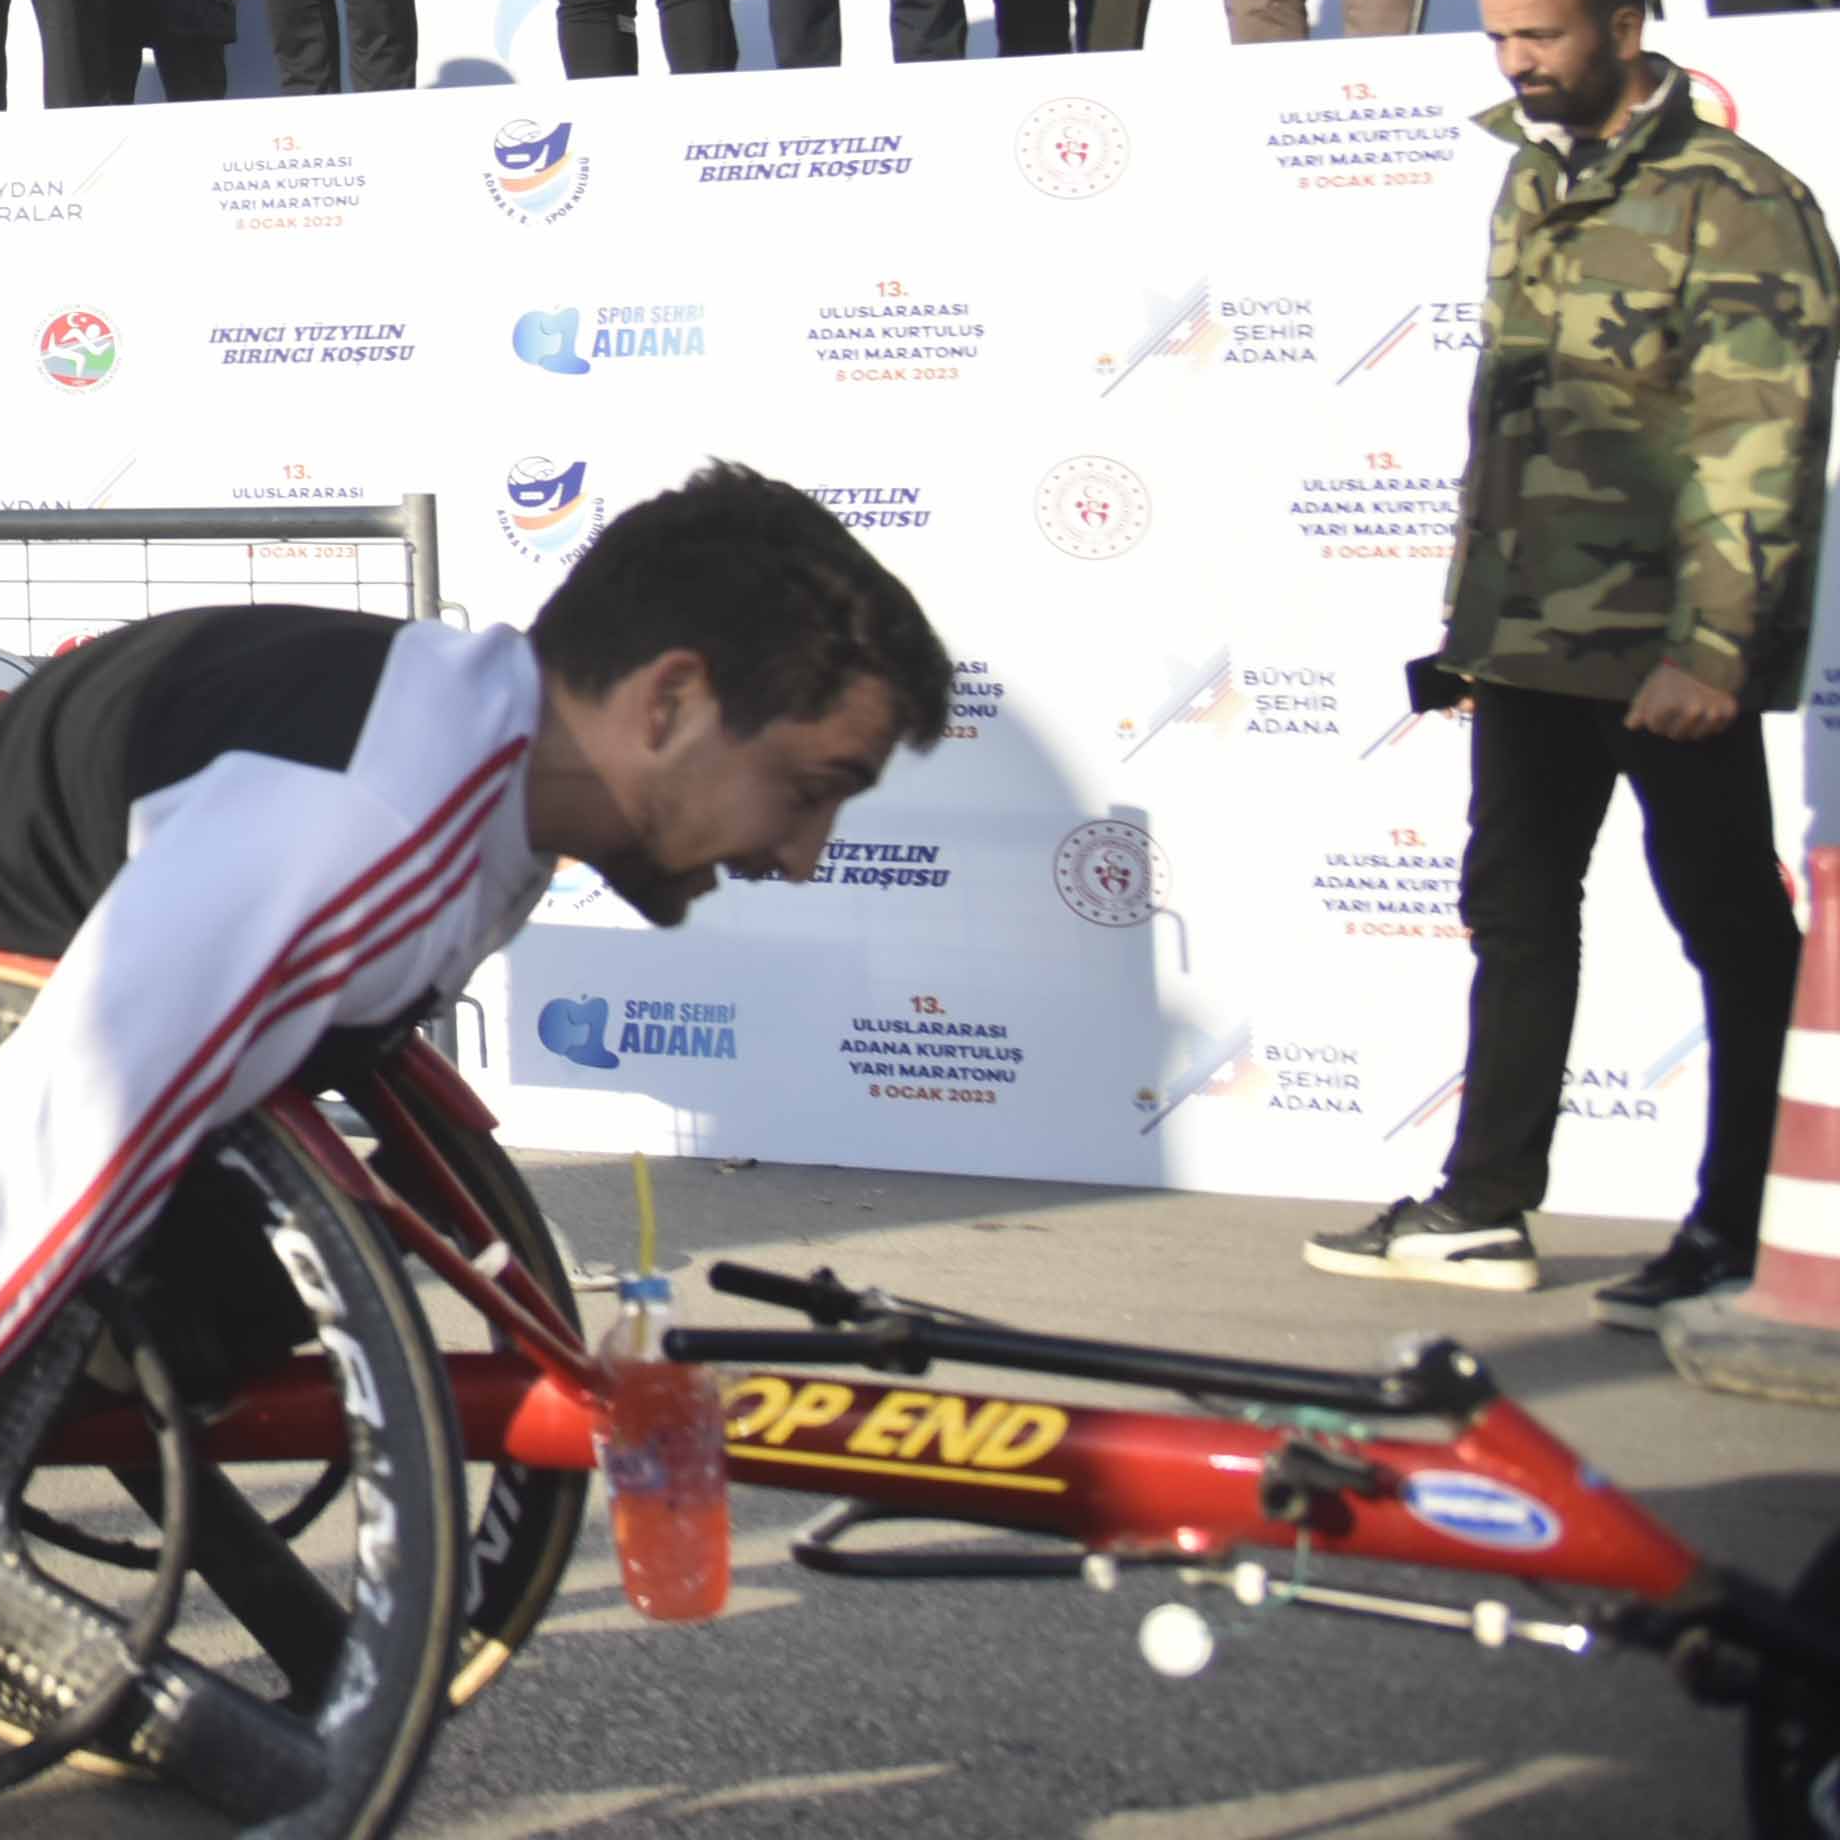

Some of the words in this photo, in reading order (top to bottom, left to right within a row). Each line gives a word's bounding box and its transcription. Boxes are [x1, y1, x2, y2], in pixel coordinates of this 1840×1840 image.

[1221, 296, 1313, 318] BÜYÜK
[1232, 321, 1315, 346] ŞEHİR
[1223, 347, 1316, 366] ADANA
[624, 1000, 675, 1024] SPOR
[678, 1002, 738, 1028] ŞEHRİ
[910, 996, 946, 1014] 13.
[853, 1018, 1007, 1039] ULUSLARARASI
[618, 1022, 738, 1061] ADANA
[840, 1040, 912, 1056] ADANA
[916, 1044, 1023, 1064] KURTULUŞ
[849, 1061, 895, 1076] YARI
[899, 1064, 1016, 1083] MARATONU
[869, 1085, 881, 1097] 8
[885, 1085, 942, 1101] OCAK
[948, 1089, 995, 1103] 2023
[724, 1376, 855, 1445] OP
[845, 1390, 1070, 1470] END
